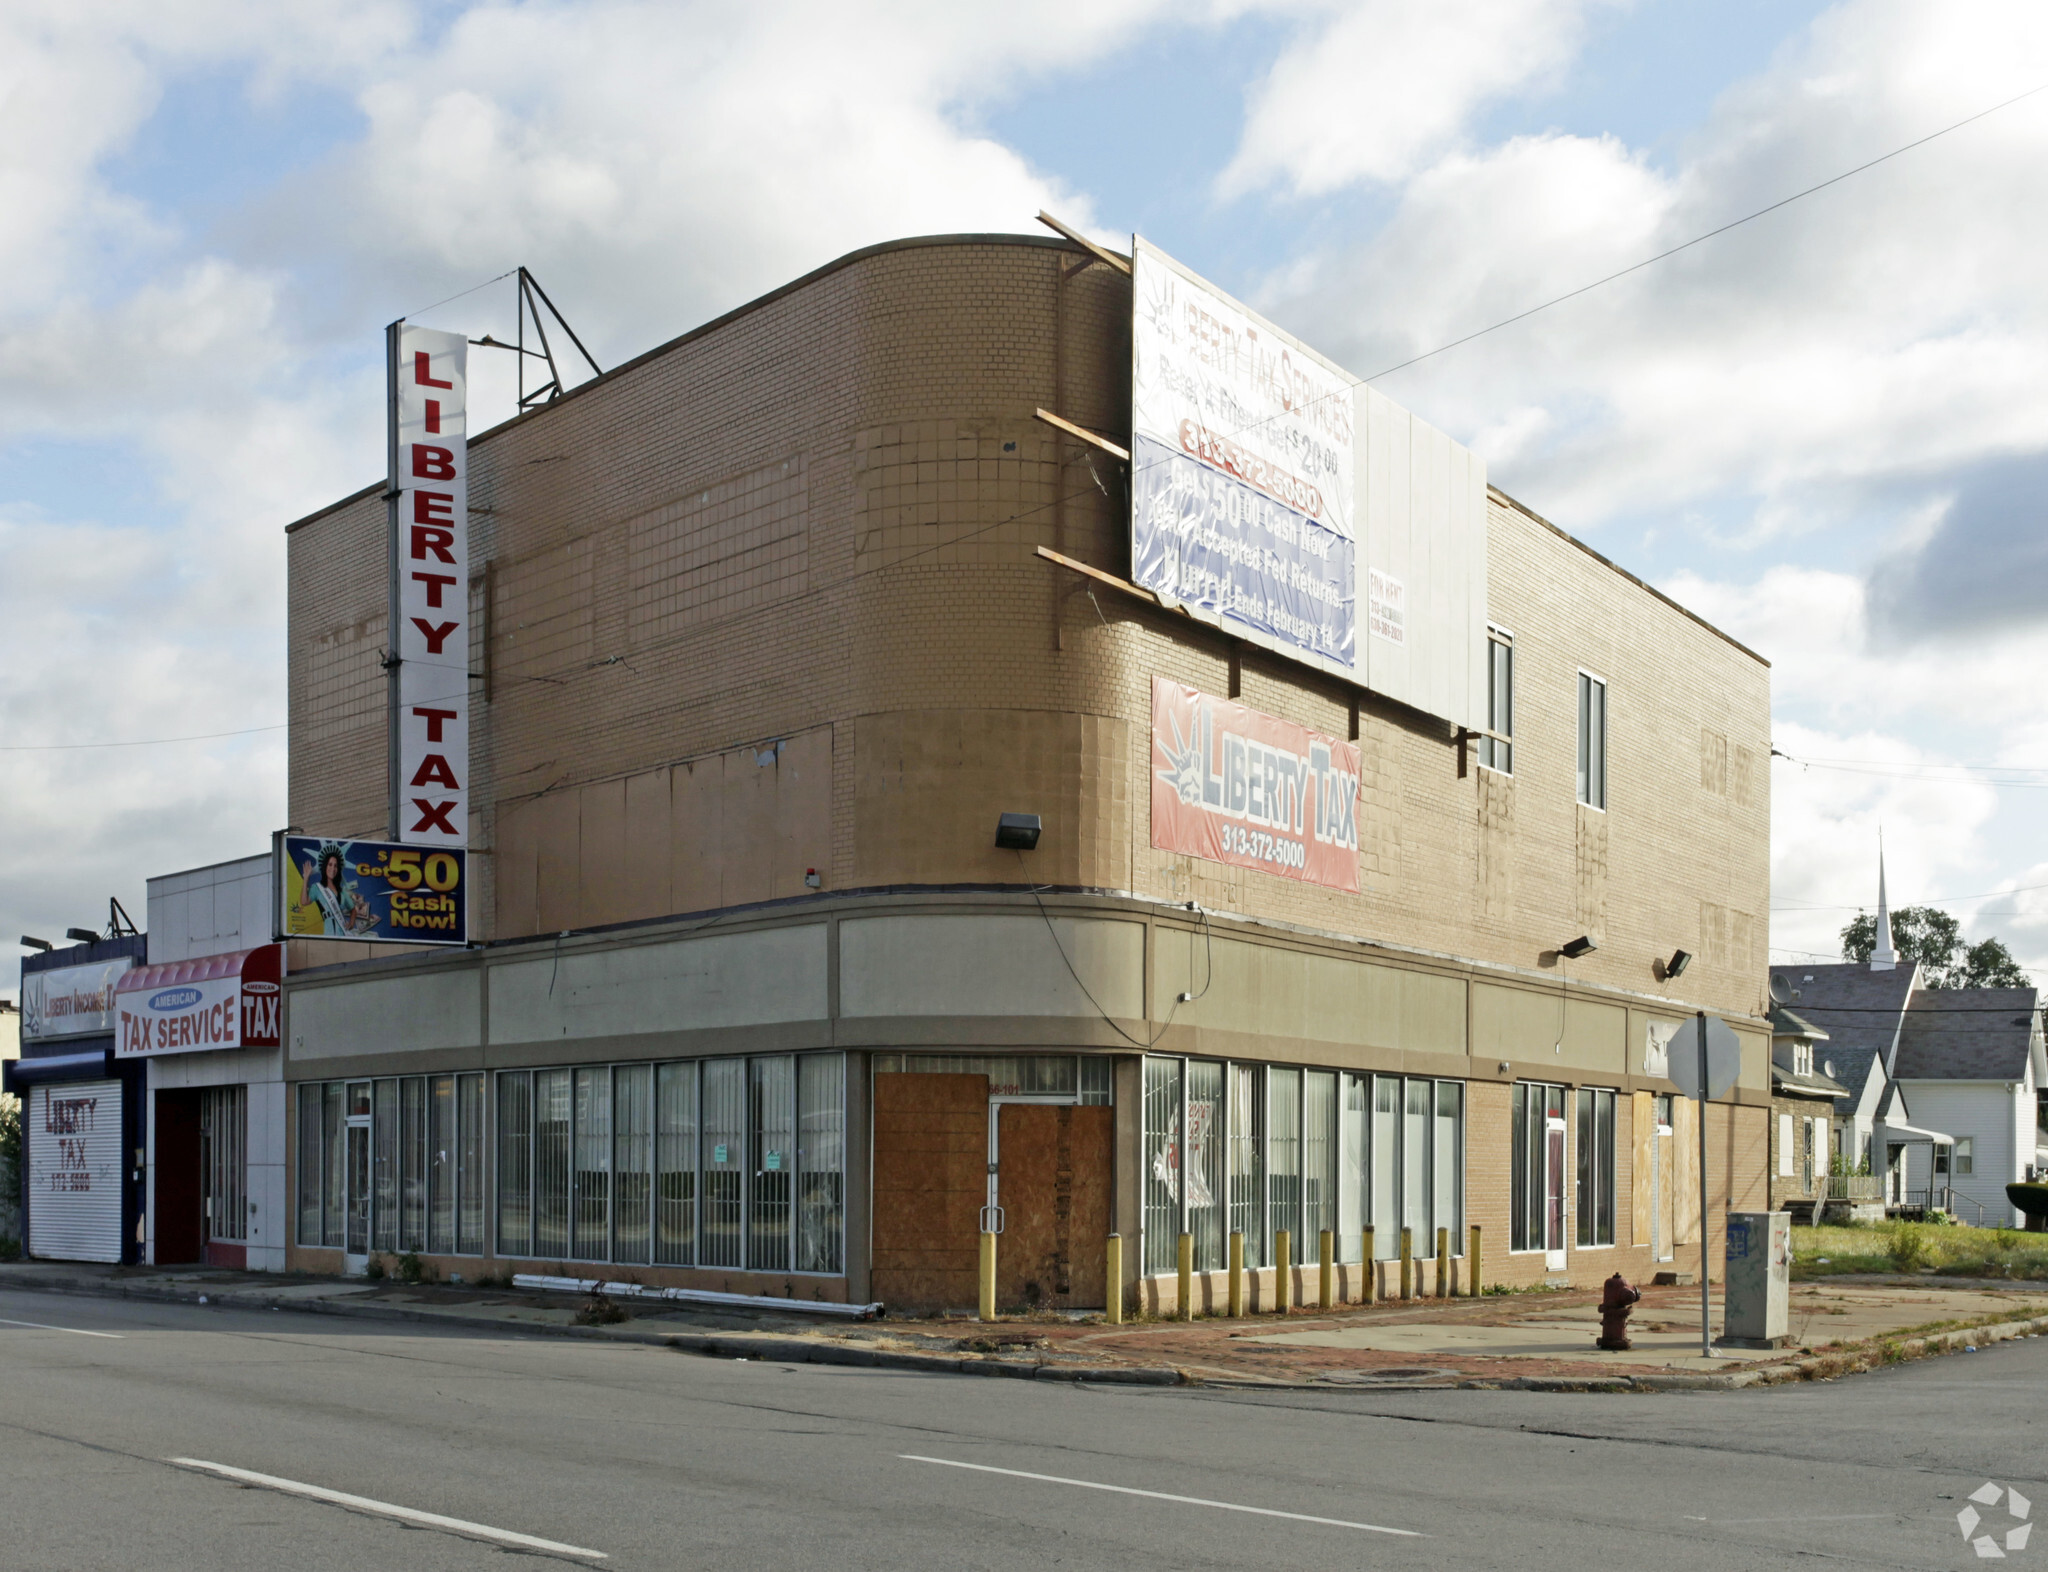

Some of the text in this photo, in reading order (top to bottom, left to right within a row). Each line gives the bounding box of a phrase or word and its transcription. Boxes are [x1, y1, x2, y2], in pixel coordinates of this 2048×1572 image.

[1246, 328, 1277, 404] TAX
[1264, 503, 1297, 546] Cash
[1192, 516, 1261, 571] Accepted
[1264, 549, 1288, 585] Fed
[409, 351, 460, 835] LIBERTY TAX
[1234, 584, 1263, 620] Ends
[1267, 600, 1317, 648] February
[1320, 623, 1333, 649] 14
[1200, 702, 1358, 850] LIBERTY TAX
[1222, 823, 1305, 869] 313-372-5000
[356, 862, 390, 878] Get
[390, 891, 455, 912] Cash
[390, 910, 456, 930] Now!
[44, 992, 73, 1018] LIBERTY
[74, 988, 104, 1014] INCOME
[154, 991, 196, 1009] AMERICAN
[246, 983, 275, 991] AMERICAN
[121, 995, 235, 1052] TAX SERVICE
[242, 995, 279, 1038] TAX
[45, 1088, 97, 1135] LIBERTY
[59, 1138, 86, 1170] TAX
